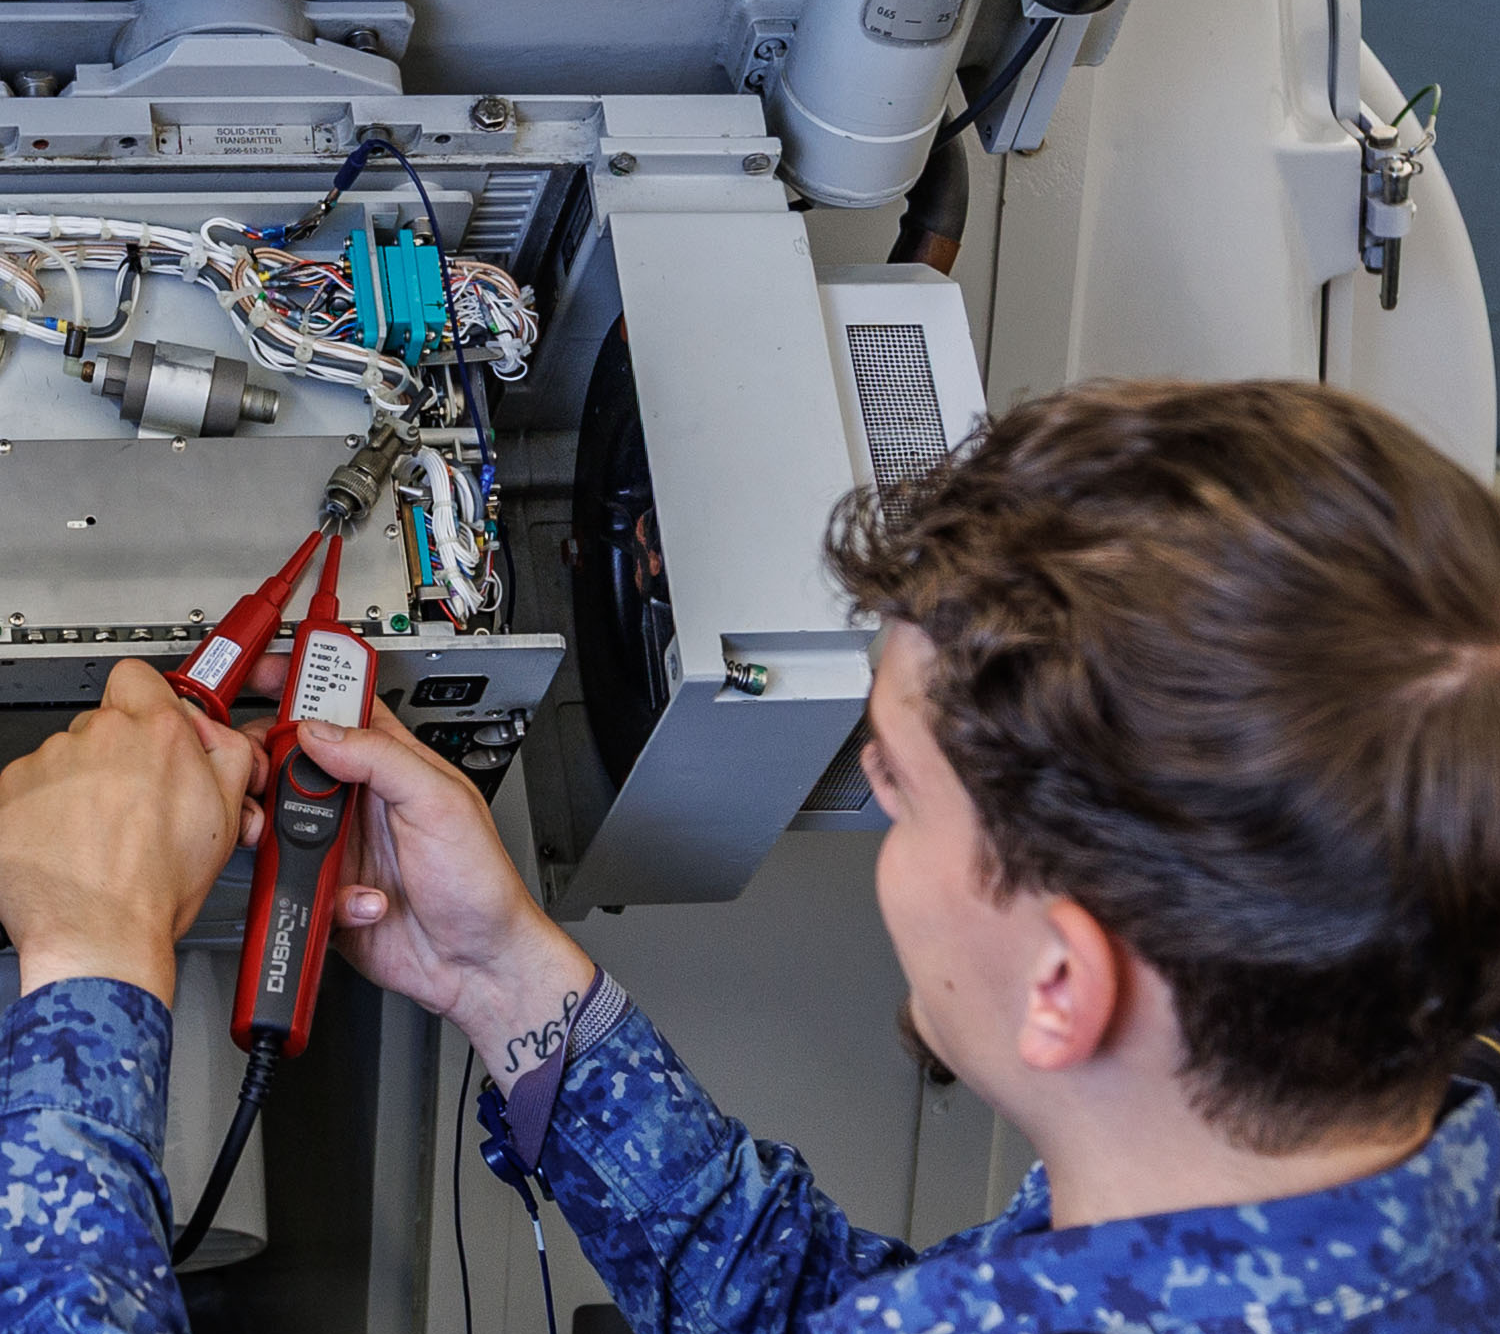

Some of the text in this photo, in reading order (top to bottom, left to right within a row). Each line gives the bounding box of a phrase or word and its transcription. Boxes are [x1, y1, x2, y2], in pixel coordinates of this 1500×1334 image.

[217, 128, 278, 136] SOLID-STATE
[215, 136, 282, 145] TRANSMITTER
[319, 643, 338, 652] 1000
[315, 663, 330, 672] 400
[313, 673, 329, 683] 230
[312, 684, 326, 693] 120
[310, 694, 320, 702] 50
[308, 705, 318, 713] 24
[284, 800, 334, 818] BENNING
